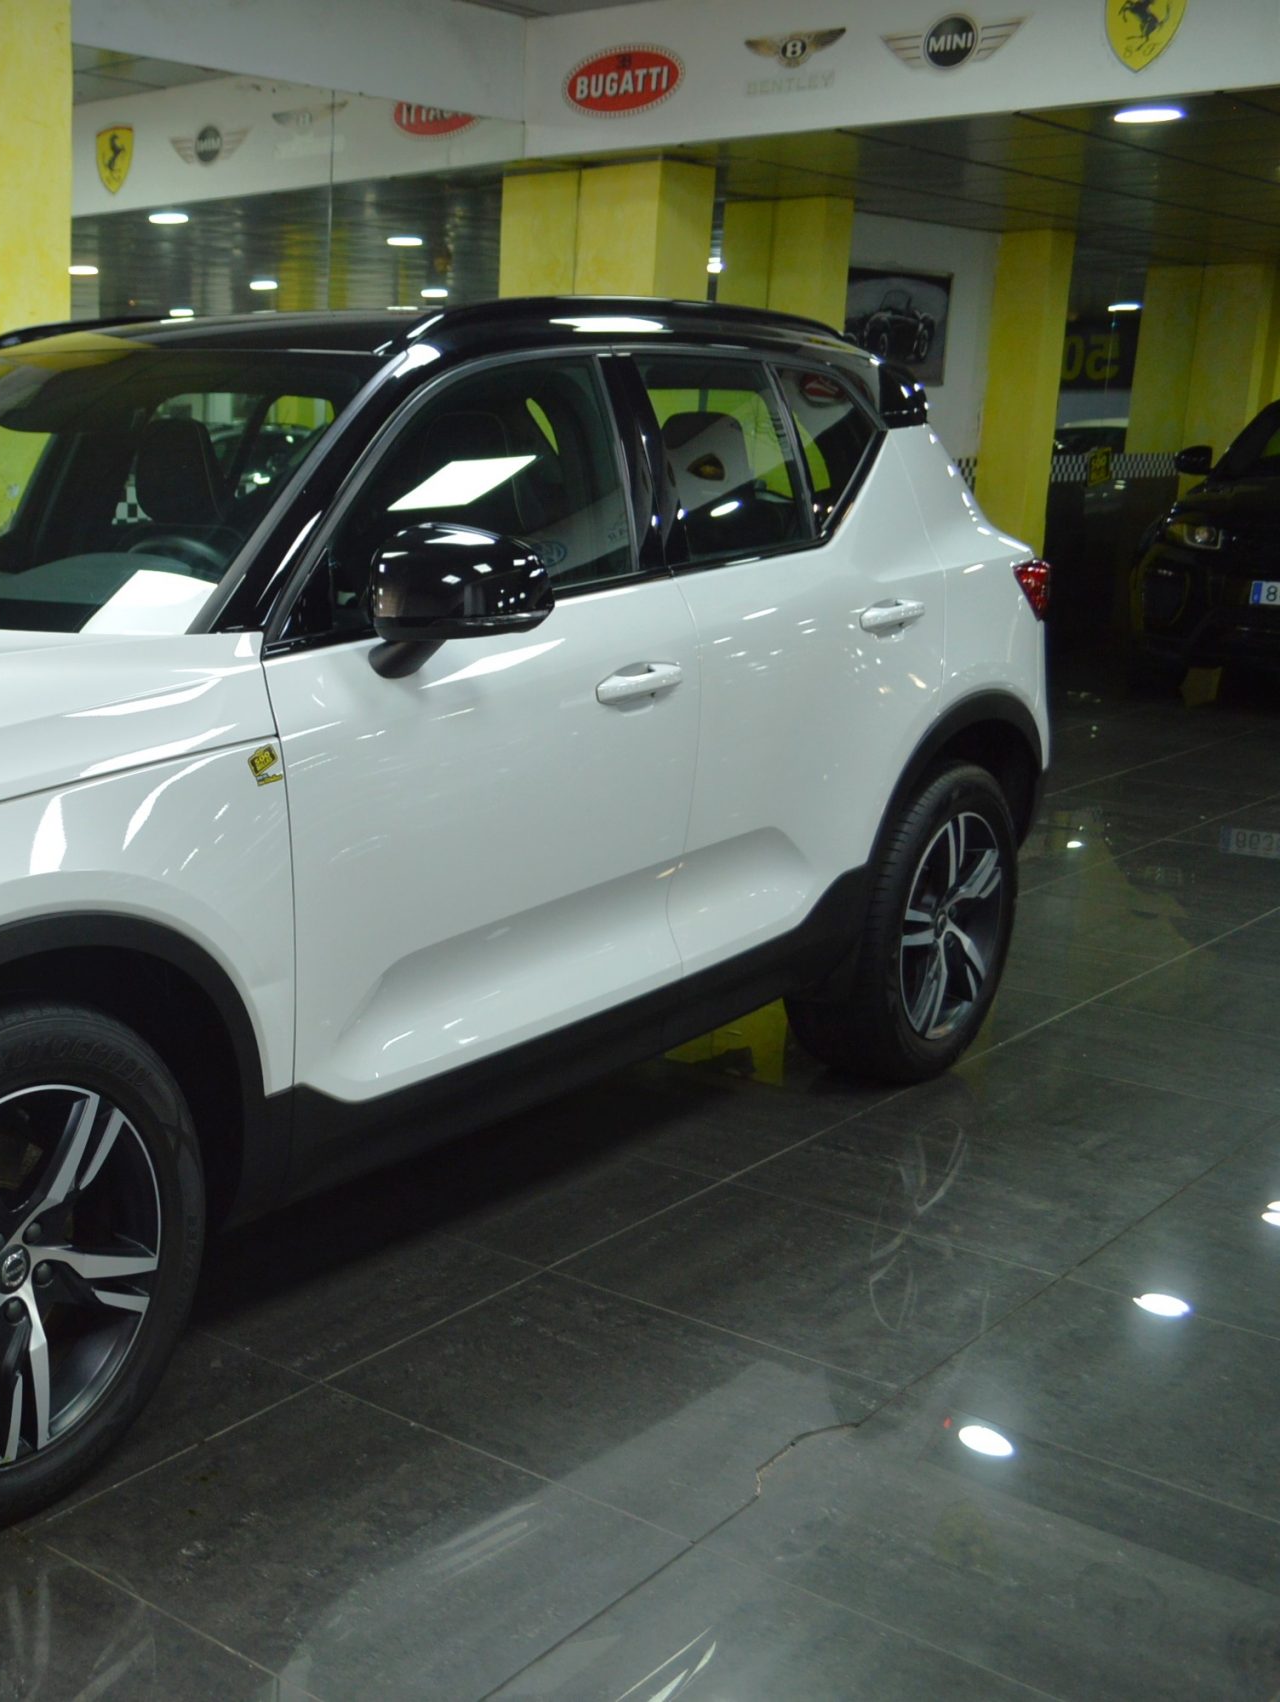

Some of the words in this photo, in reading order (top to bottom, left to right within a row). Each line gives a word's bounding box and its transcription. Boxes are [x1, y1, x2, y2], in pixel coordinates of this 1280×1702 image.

[928, 31, 973, 54] MINI
[576, 65, 669, 101] BUGATTI
[745, 69, 836, 97] BENTLEY
